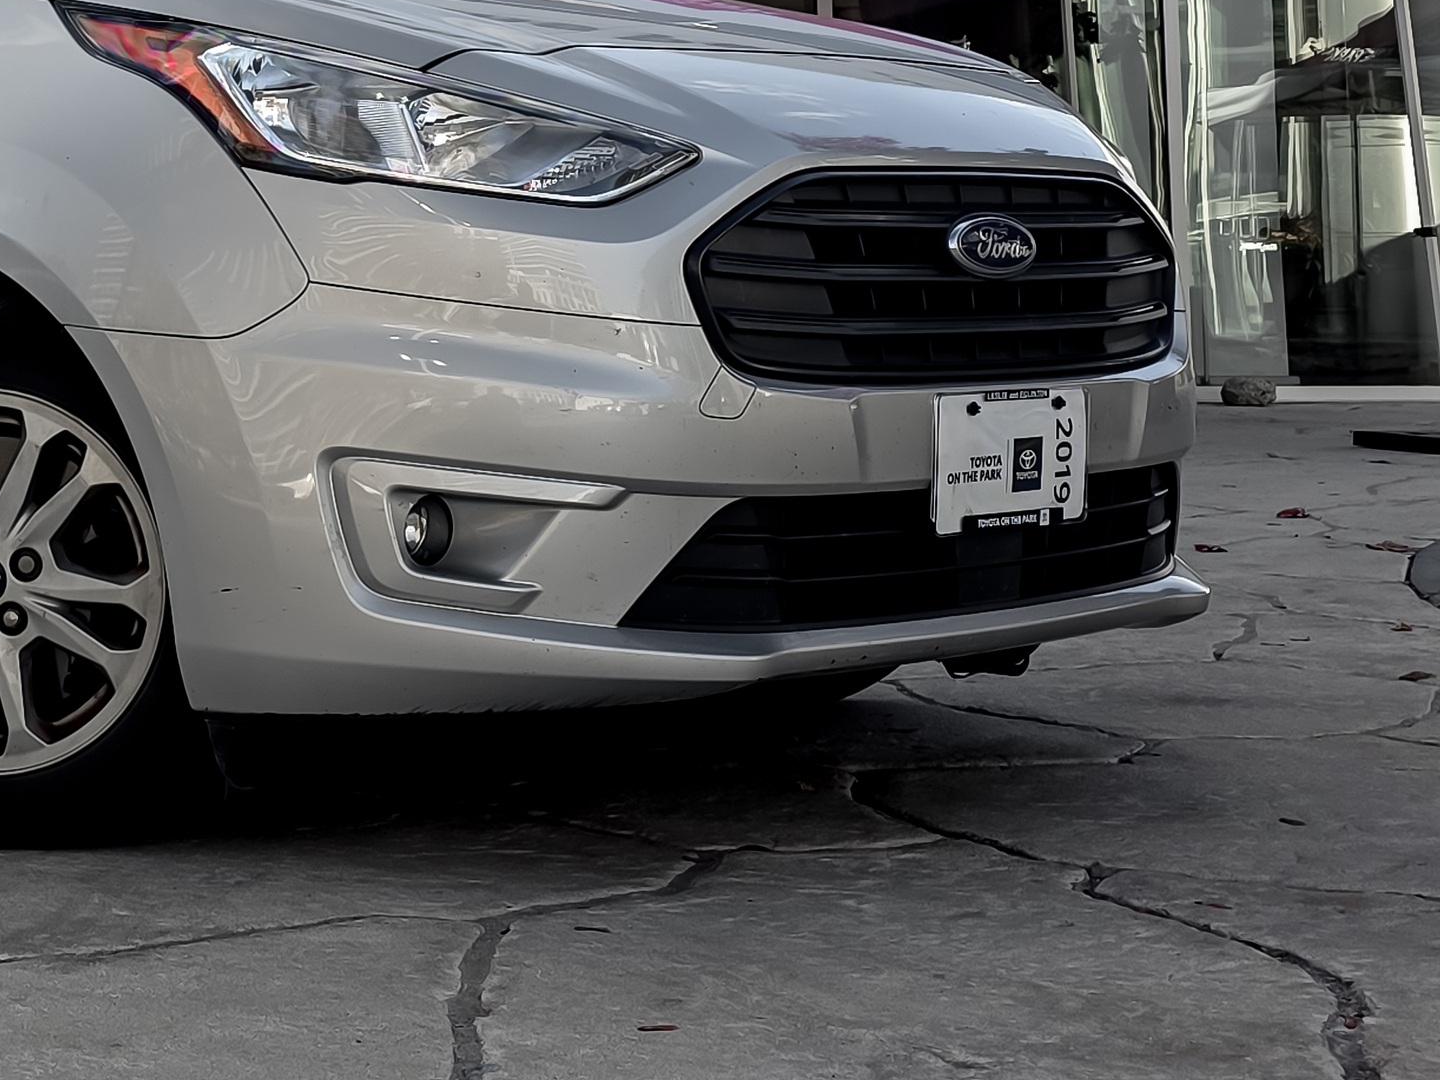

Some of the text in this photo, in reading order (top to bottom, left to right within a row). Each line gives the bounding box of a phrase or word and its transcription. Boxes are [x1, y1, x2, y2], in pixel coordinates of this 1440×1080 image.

[969, 454, 1003, 469] TOYOTA
[1053, 417, 1073, 504] 2019
[947, 468, 1003, 485] ON THE PARK
